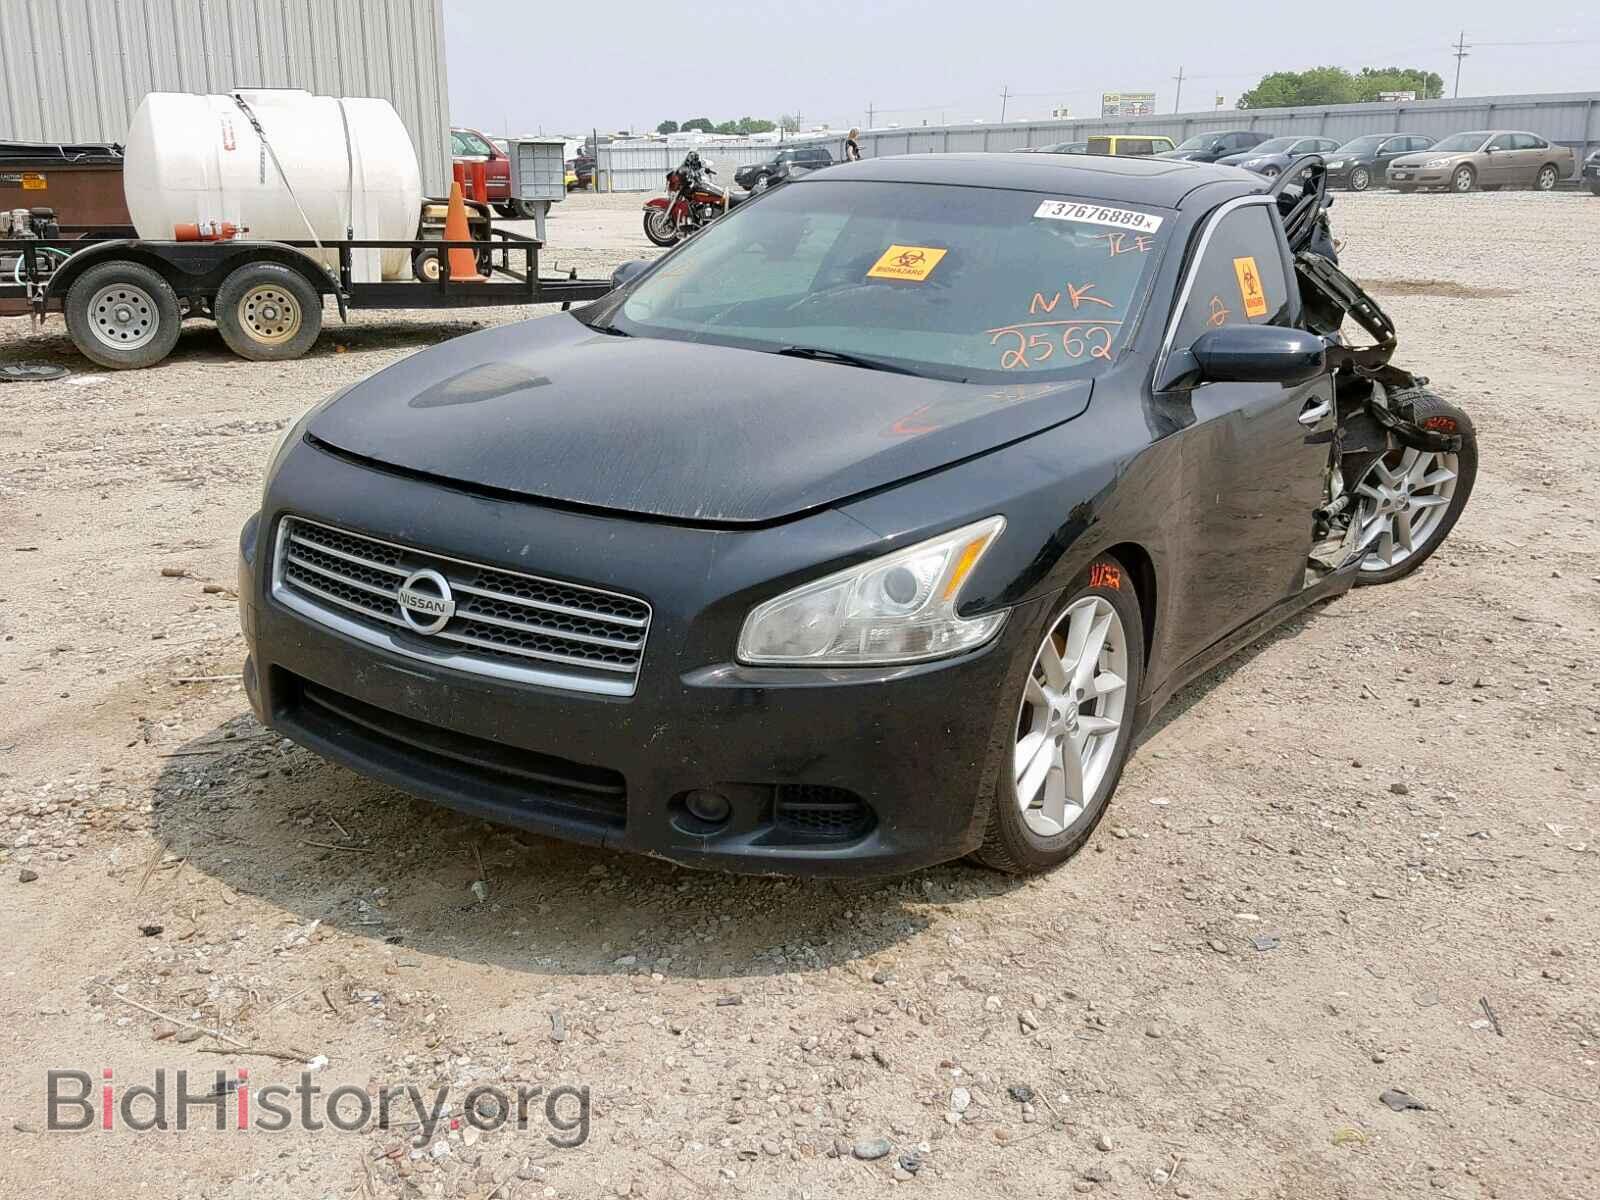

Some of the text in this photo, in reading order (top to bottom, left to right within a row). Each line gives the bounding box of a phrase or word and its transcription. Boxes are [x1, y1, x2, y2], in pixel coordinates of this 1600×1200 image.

[1051, 202, 1146, 228] 37676889
[989, 326, 1113, 369] 2562
[399, 591, 446, 613] NISSAN
